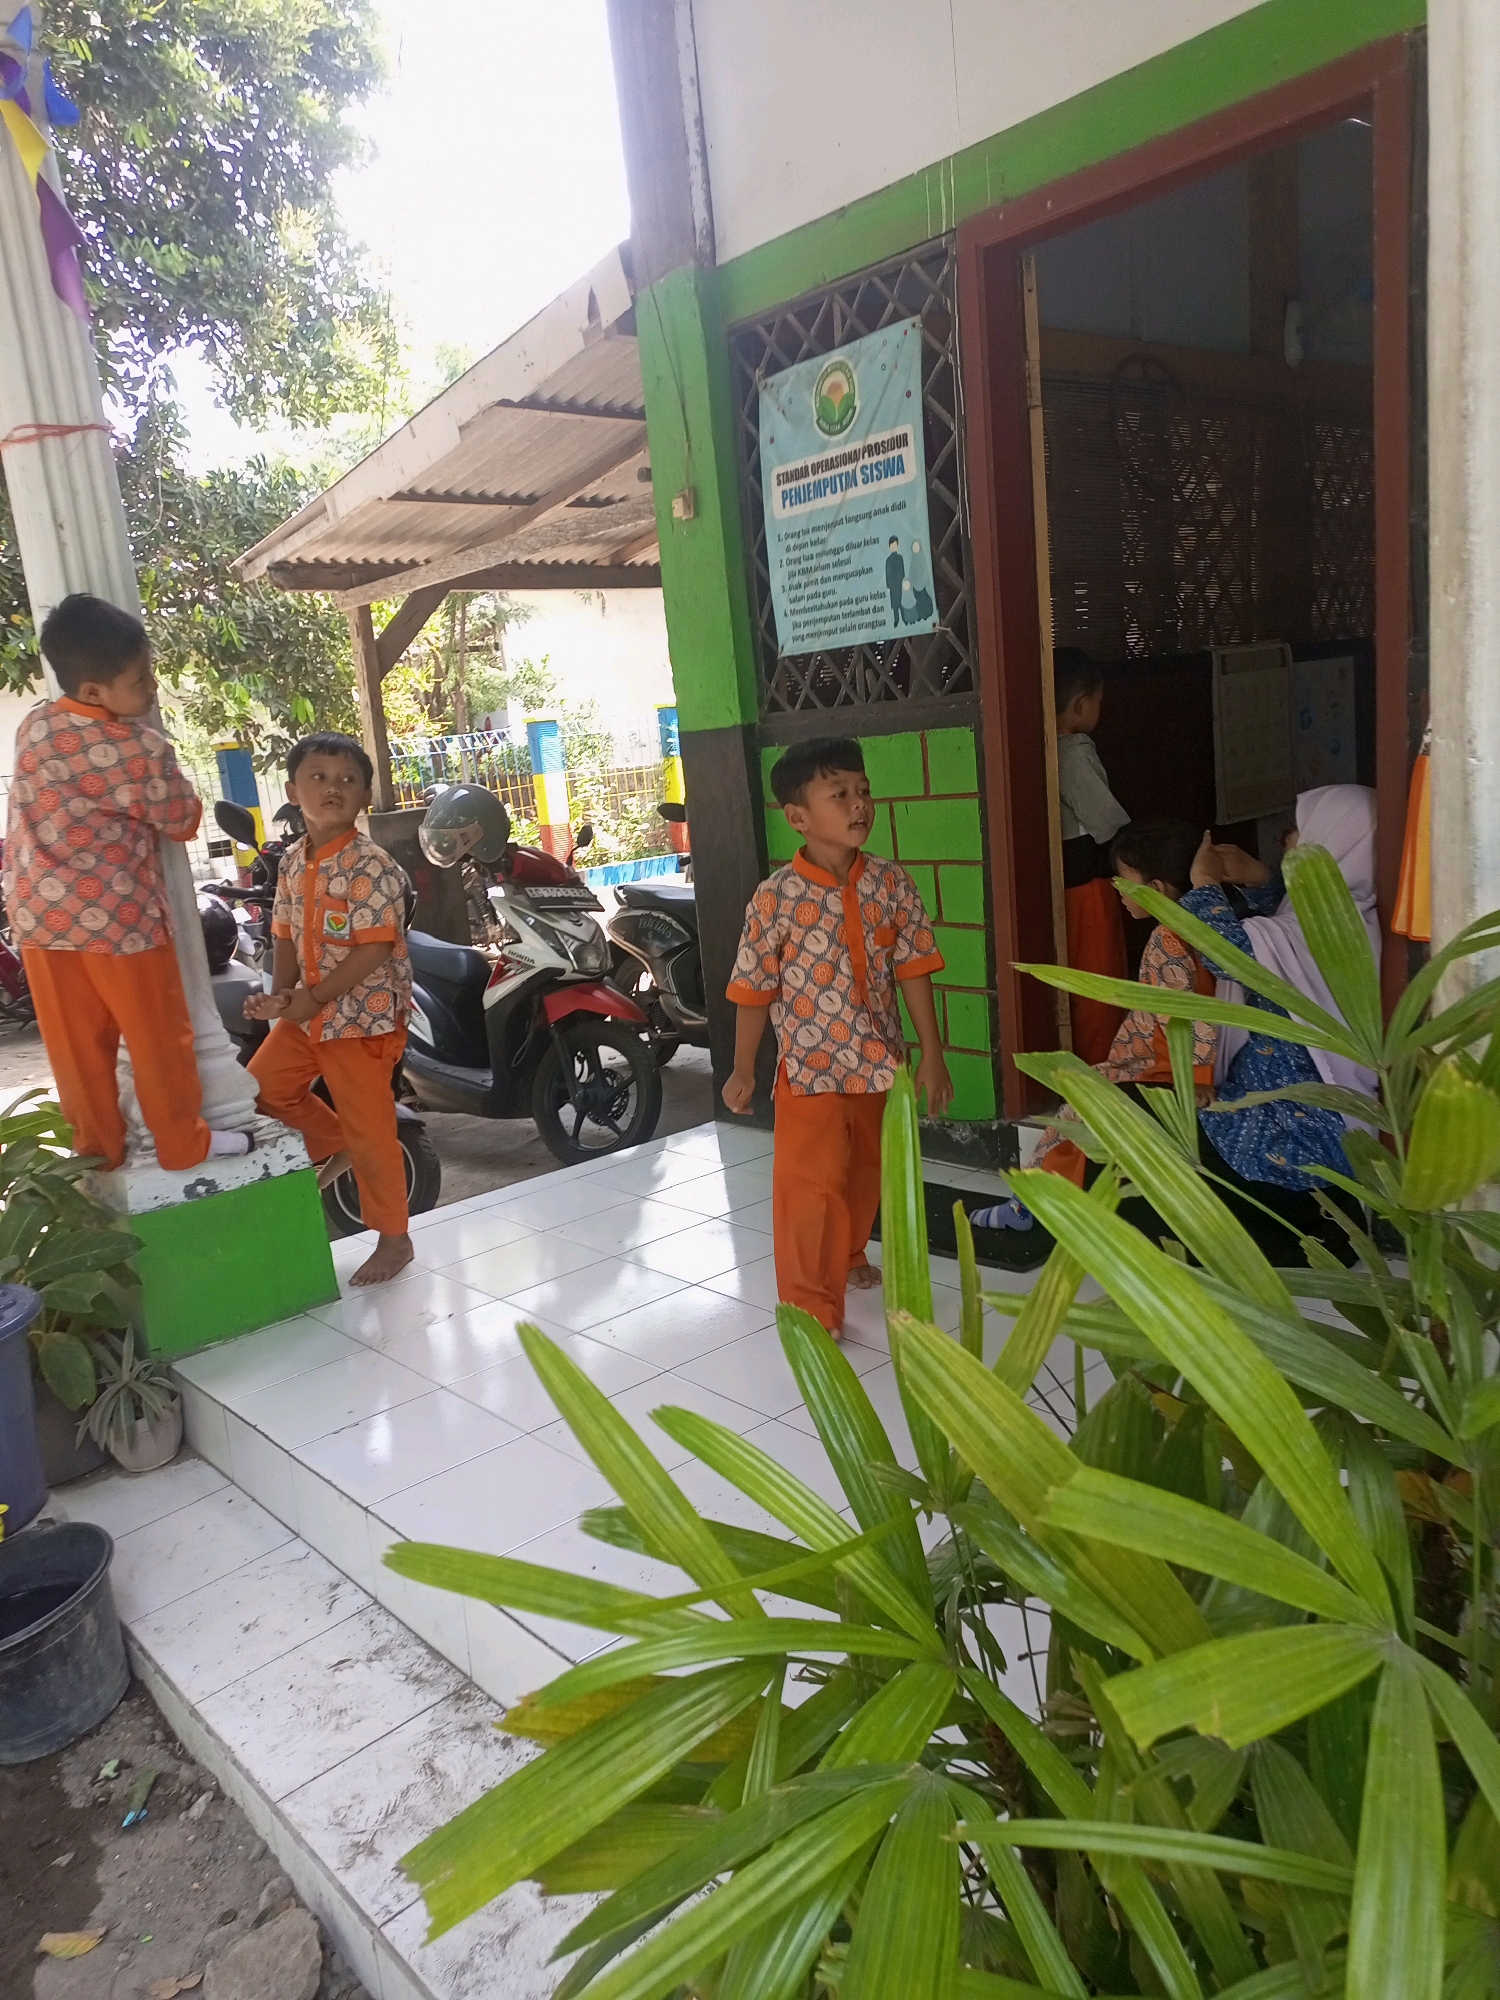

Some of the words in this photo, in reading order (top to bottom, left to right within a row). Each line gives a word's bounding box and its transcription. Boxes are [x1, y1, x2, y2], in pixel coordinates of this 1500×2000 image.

[776, 464, 810, 488] STANDAR
[861, 432, 909, 461] PROSEDUR
[781, 468, 858, 510] PENJEMPUTAN
[860, 453, 906, 486] SISWA
[777, 533, 783, 543] 1.
[784, 529, 800, 542] Orang
[802, 526, 810, 536] tua
[845, 508, 872, 525] langsung
[873, 504, 889, 517] anak
[891, 499, 907, 512] didik
[779, 559, 784, 568] 2.
[786, 555, 802, 568] Orang
[803, 552, 814, 562] tua
[845, 540, 863, 552] diluar
[863, 535, 880, 547] kelas
[785, 544, 791, 553] di
[792, 540, 809, 553] depan
[781, 584, 787, 594] 3.
[788, 580, 803, 592] Anak
[820, 574, 832, 585] dan
[832, 564, 873, 583] mengucapkan
[798, 565, 813, 576] KBM
[832, 555, 852, 568] selesai
[783, 608, 789, 618] 4.
[790, 599, 838, 617] Memberitahukan
[839, 596, 854, 609] pada
[855, 595, 869, 606] guru
[870, 589, 886, 601] kelas
[789, 593, 805, 605] salam
[806, 590, 821, 602] pada
[822, 588, 837, 600] guru.
[802, 612, 841, 630] penjemputan
[841, 606, 871, 620] terlambat
[872, 603, 885, 614] dan
[792, 634, 805, 644] yang
[806, 626, 838, 642] menjemput
[839, 622, 857, 633] selain
[858, 618, 887, 632] orangtua
[508, 950, 535, 965] HONDA
